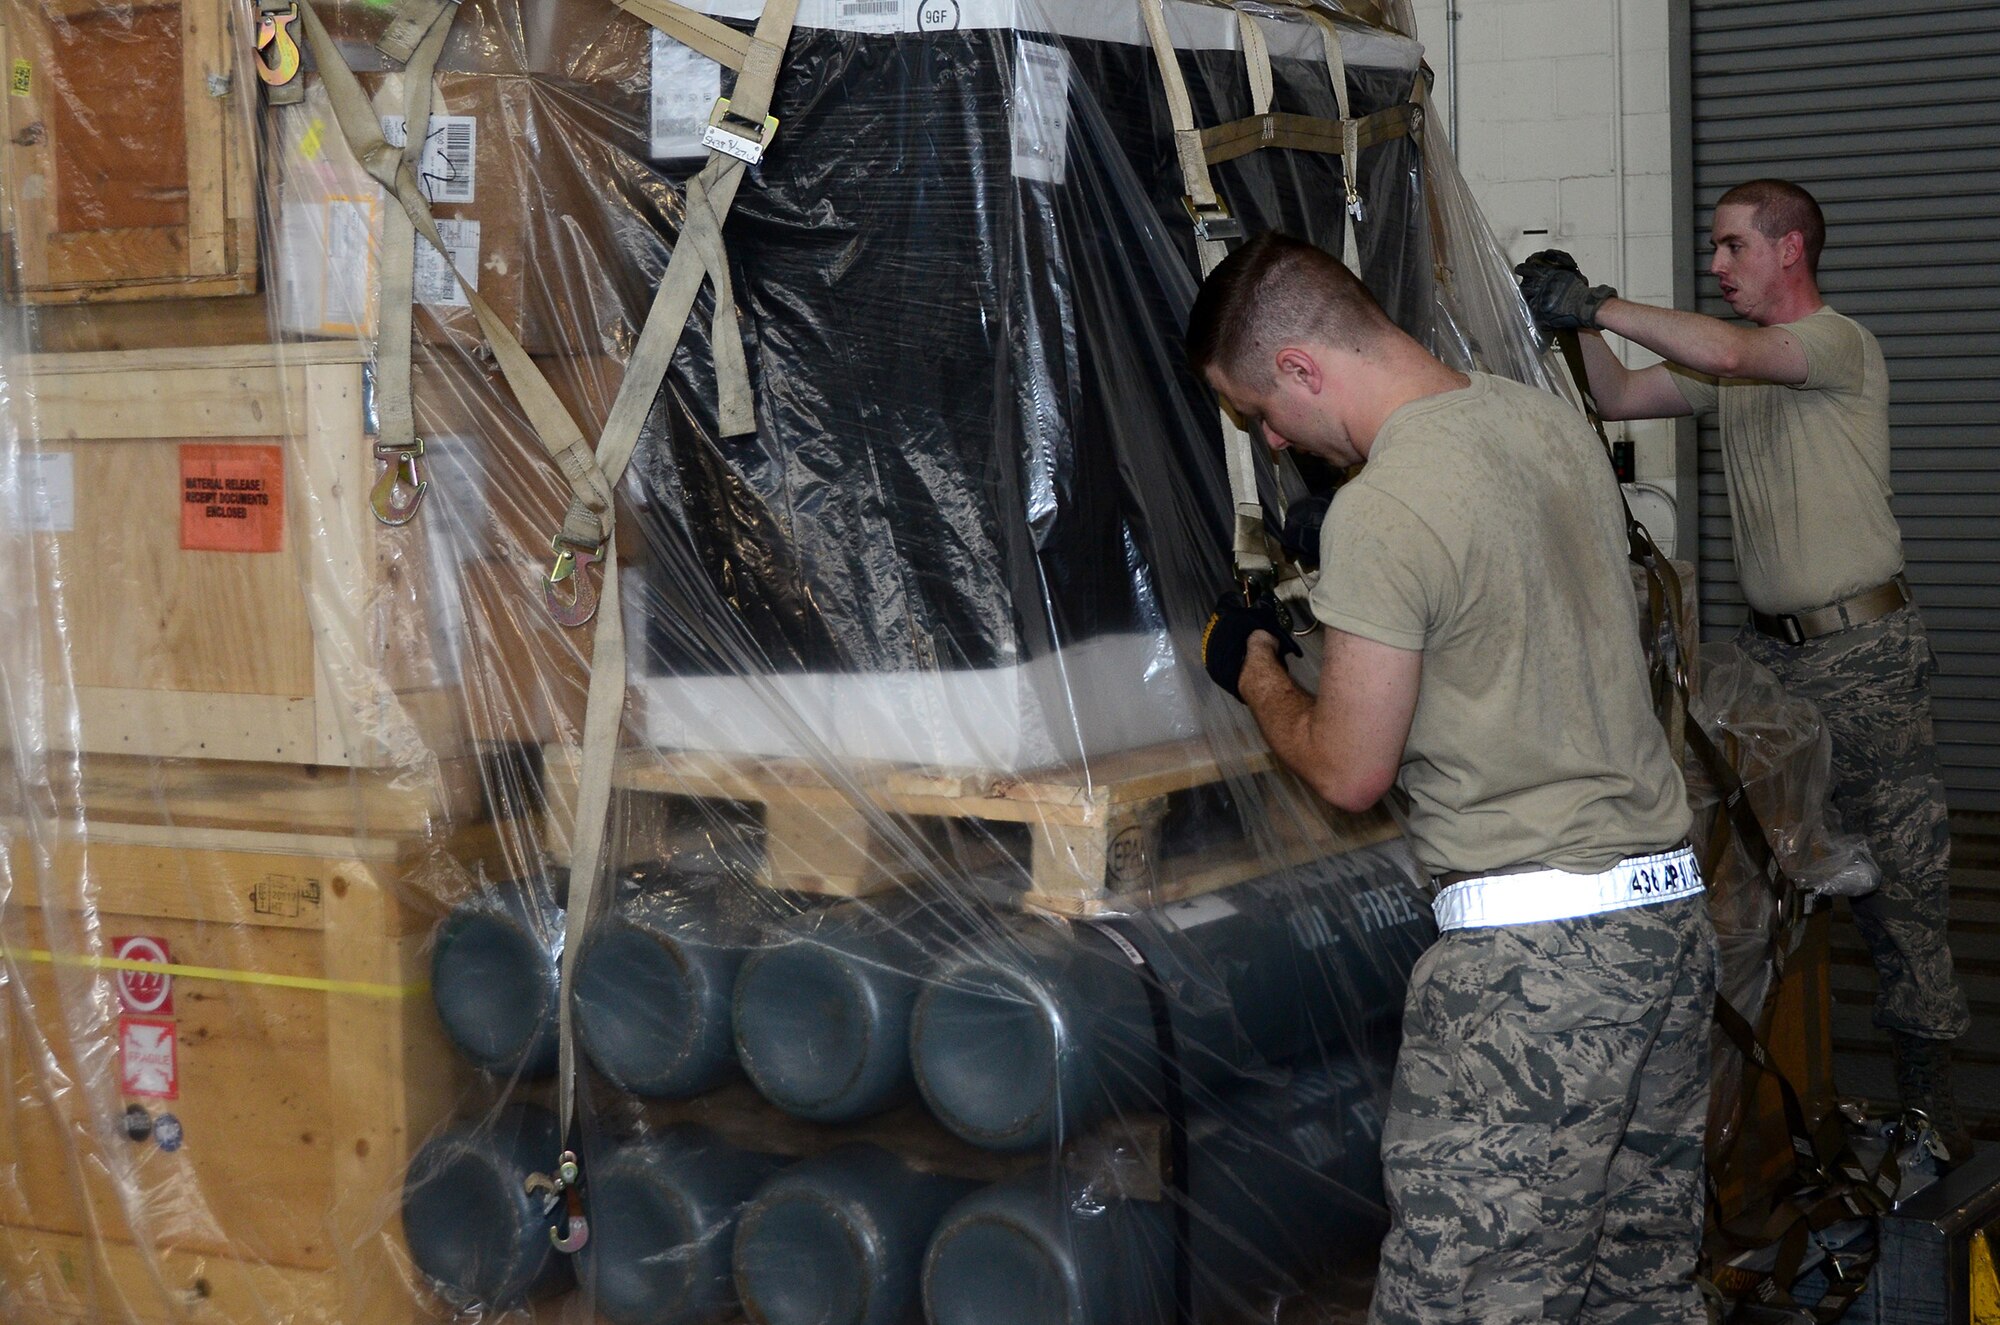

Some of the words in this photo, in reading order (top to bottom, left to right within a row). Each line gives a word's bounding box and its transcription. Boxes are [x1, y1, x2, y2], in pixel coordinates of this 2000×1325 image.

[926, 10, 947, 23] 9GF
[186, 477, 223, 490] MATERIAL
[225, 479, 260, 491] RELEASE
[185, 491, 217, 504] RECEIPT
[219, 493, 269, 506] DOCUMENTS
[206, 506, 247, 519] ENCLOSED
[1632, 867, 1660, 894] 436
[1350, 881, 1420, 934] FREE
[128, 1051, 170, 1065] FRAGILE
